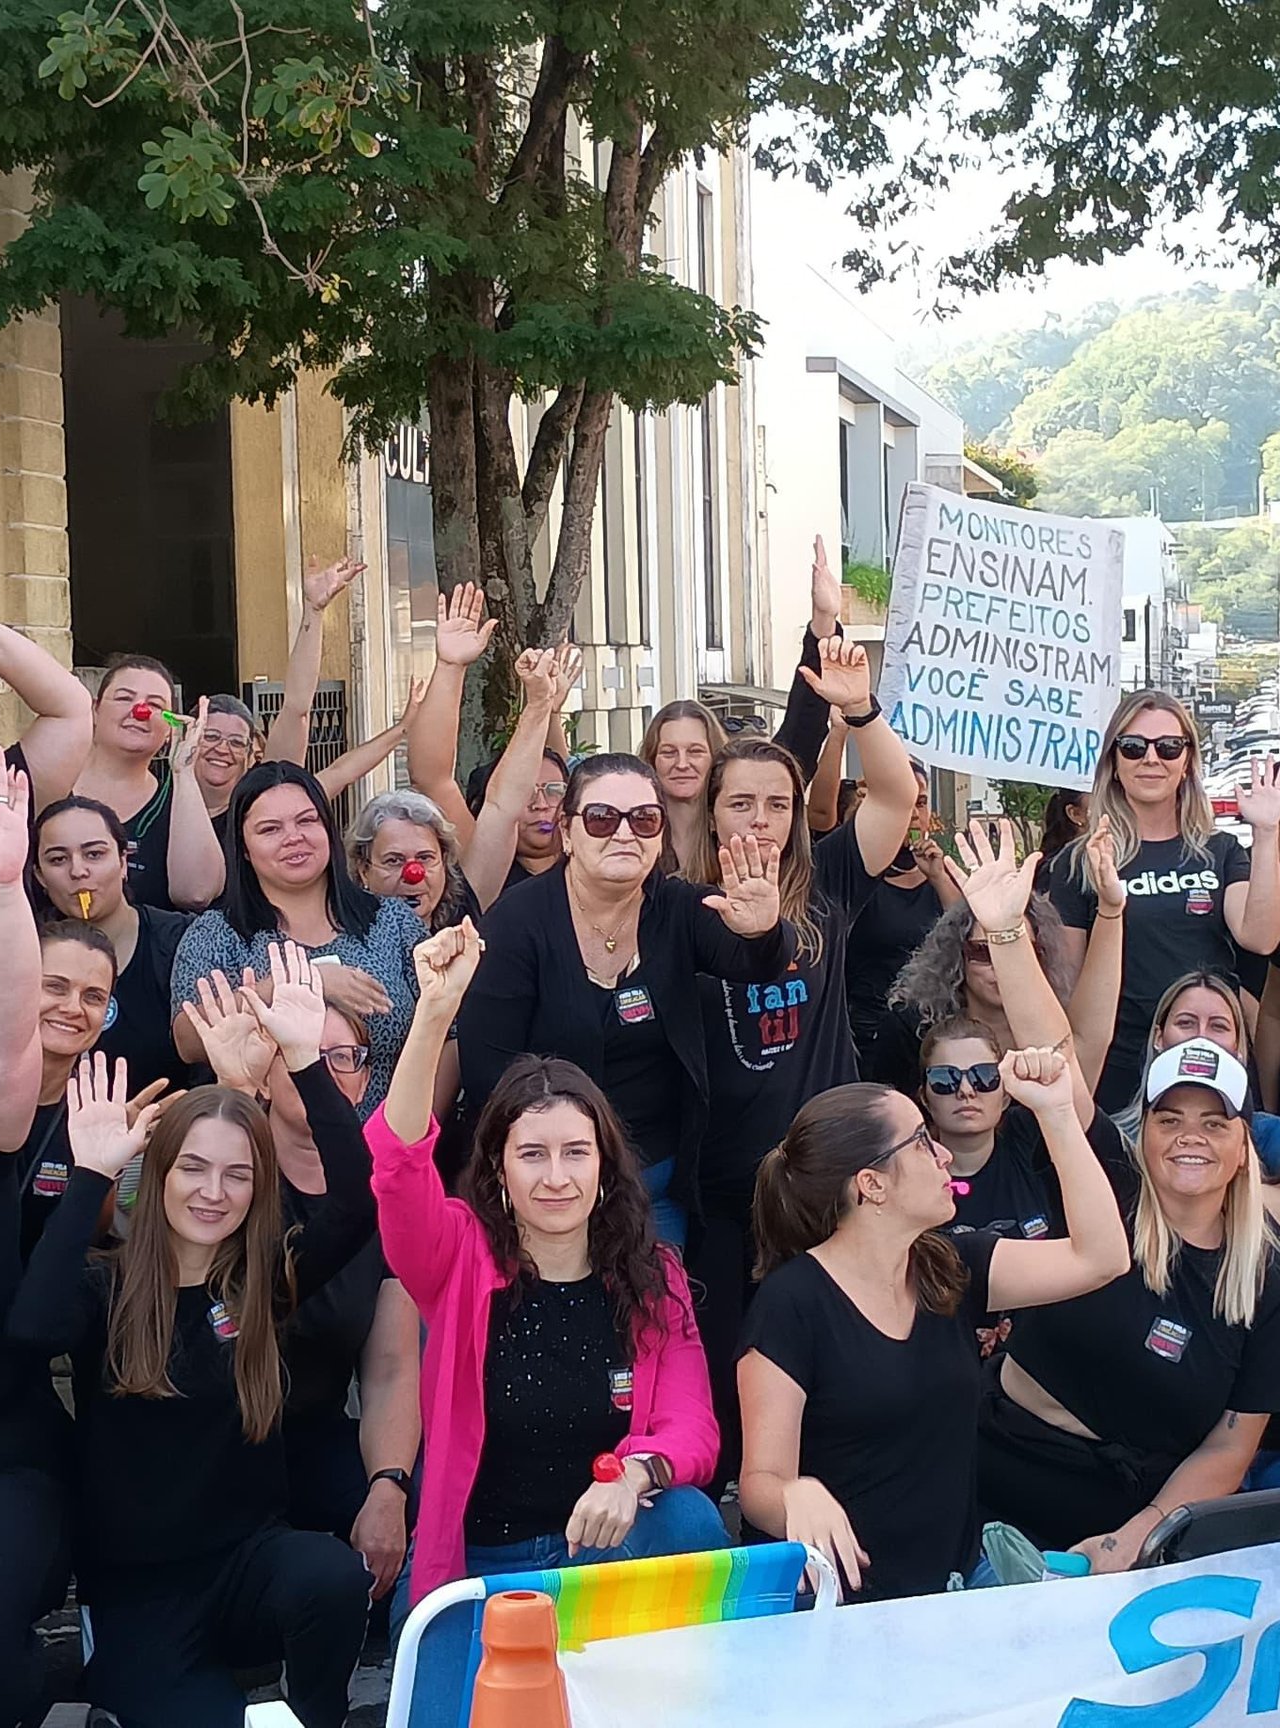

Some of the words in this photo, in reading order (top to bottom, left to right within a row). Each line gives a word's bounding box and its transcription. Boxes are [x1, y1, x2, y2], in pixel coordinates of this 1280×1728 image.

[938, 503, 1092, 560] MONITORES
[926, 537, 1094, 606] ENSINAM.
[919, 583, 1091, 643] PREFEITOS
[900, 620, 1115, 687] ADMINISTRAM.
[906, 663, 989, 701] VOCÊ
[1005, 680, 1083, 718] SABE
[889, 700, 1100, 776] ADMINISTRAR
